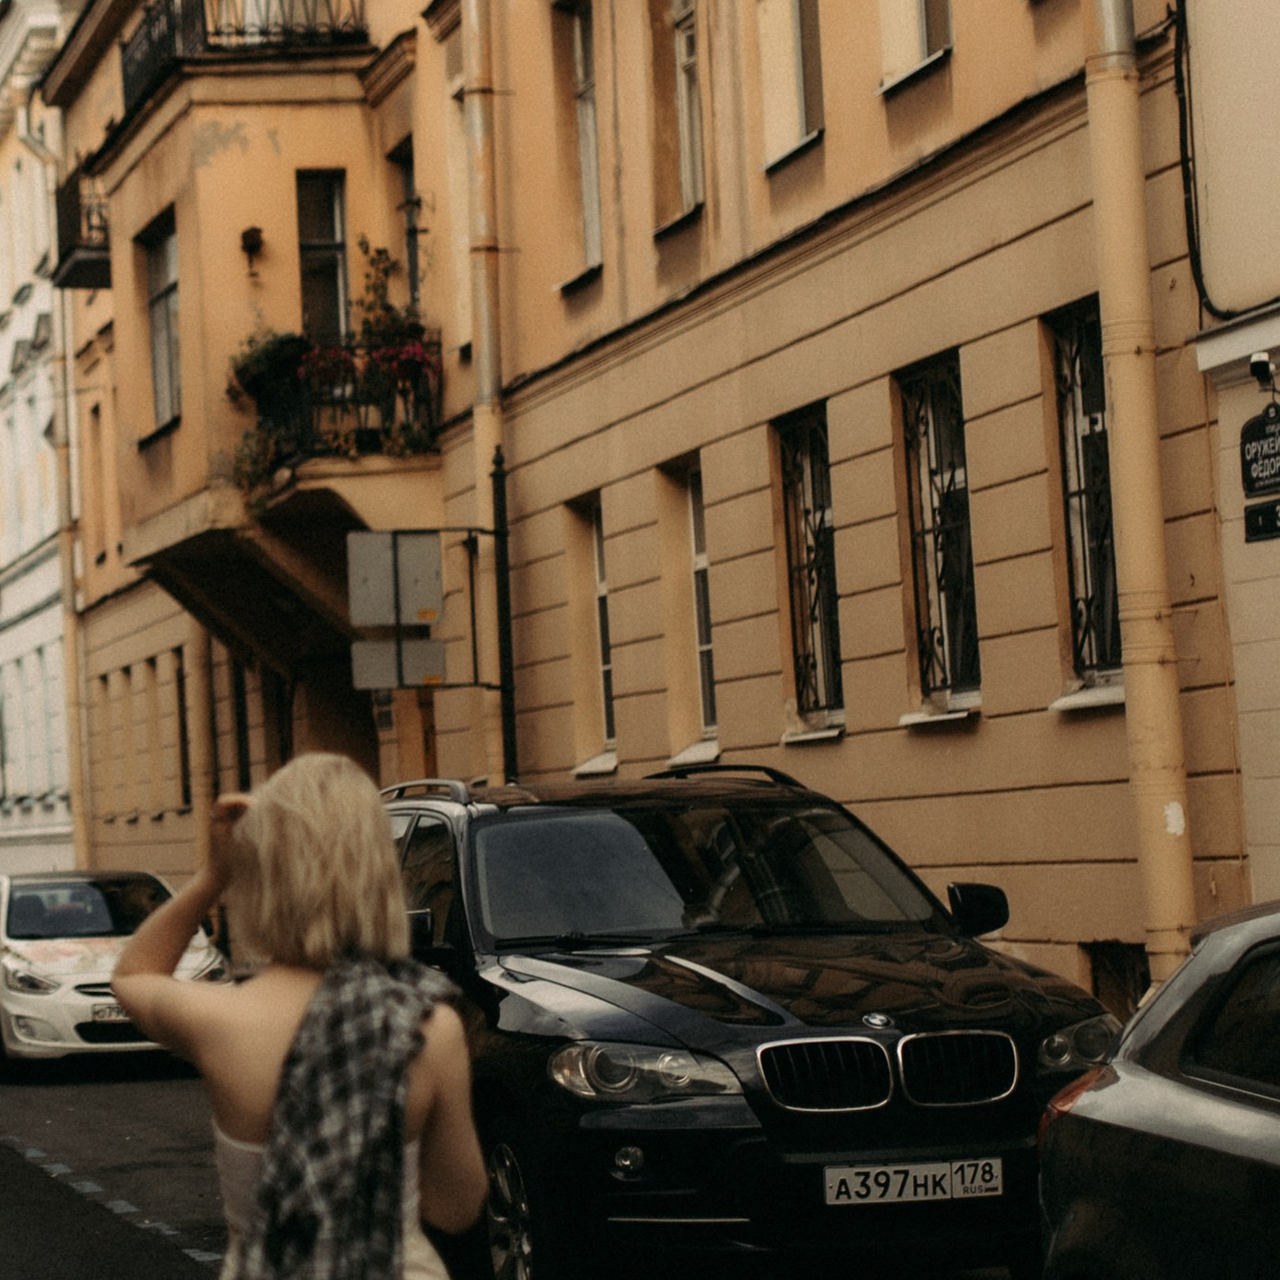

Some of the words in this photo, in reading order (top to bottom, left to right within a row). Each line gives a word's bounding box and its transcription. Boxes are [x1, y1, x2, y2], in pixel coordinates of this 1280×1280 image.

[835, 1170, 947, 1200] А397НК
[954, 1161, 994, 1185] 178
[963, 1184, 984, 1194] RUS
